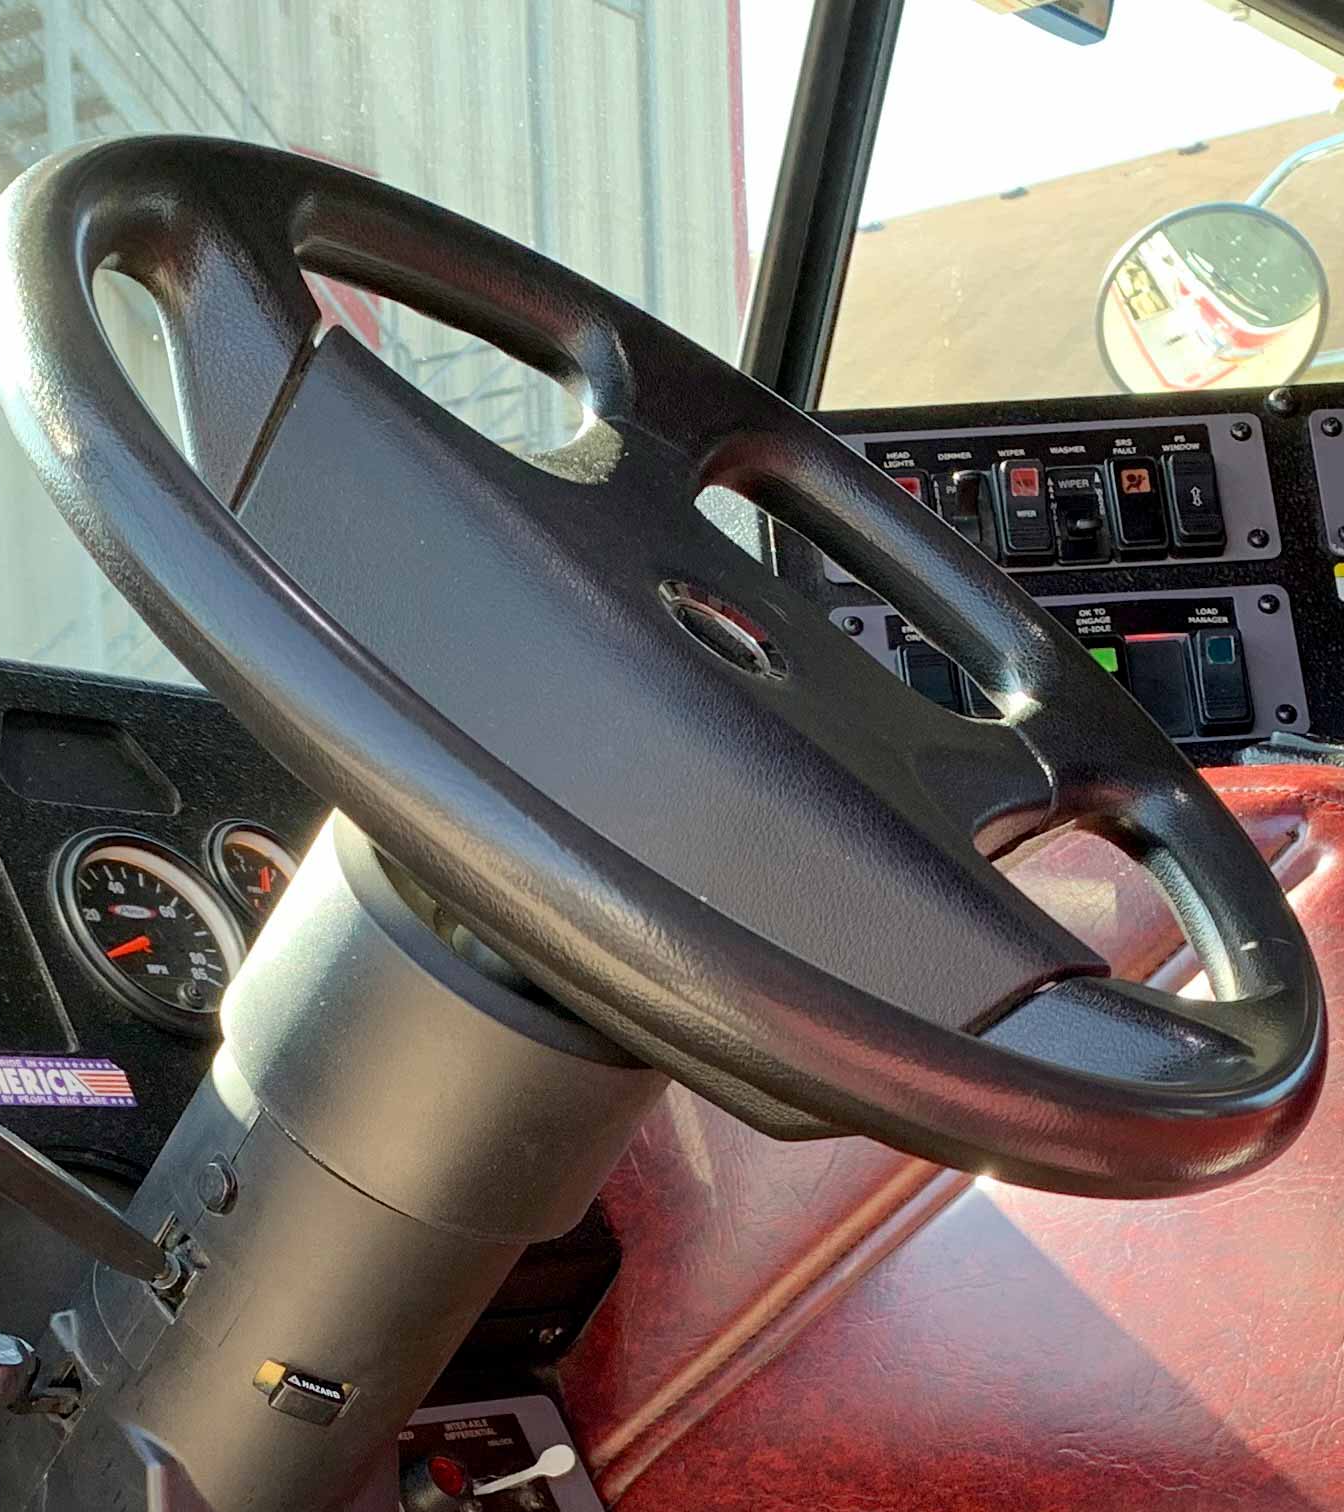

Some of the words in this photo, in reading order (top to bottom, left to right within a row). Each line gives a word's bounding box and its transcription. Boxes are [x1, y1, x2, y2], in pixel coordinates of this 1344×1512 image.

[1050, 446, 1086, 454] WASHER
[1162, 443, 1200, 452] WINDOW
[886, 451, 910, 459] HEAD
[937, 452, 972, 461] DIMMER
[998, 449, 1025, 457] WIPER
[884, 460, 915, 468] LIGHTS
[1058, 479, 1090, 489] WIPER
[1076, 616, 1112, 625] ENGAGE
[1188, 616, 1229, 624] MANAGER
[108, 881, 125, 895] 40
[82, 908, 101, 922] 20
[159, 905, 177, 919] 60
[191, 967, 208, 980] 85
[1, 1095, 13, 1104] BY
[17, 1096, 53, 1105] PEOPLE
[58, 1096, 80, 1105] WHO
[82, 1096, 108, 1105] CARE
[301, 1380, 340, 1399] HAZARD
